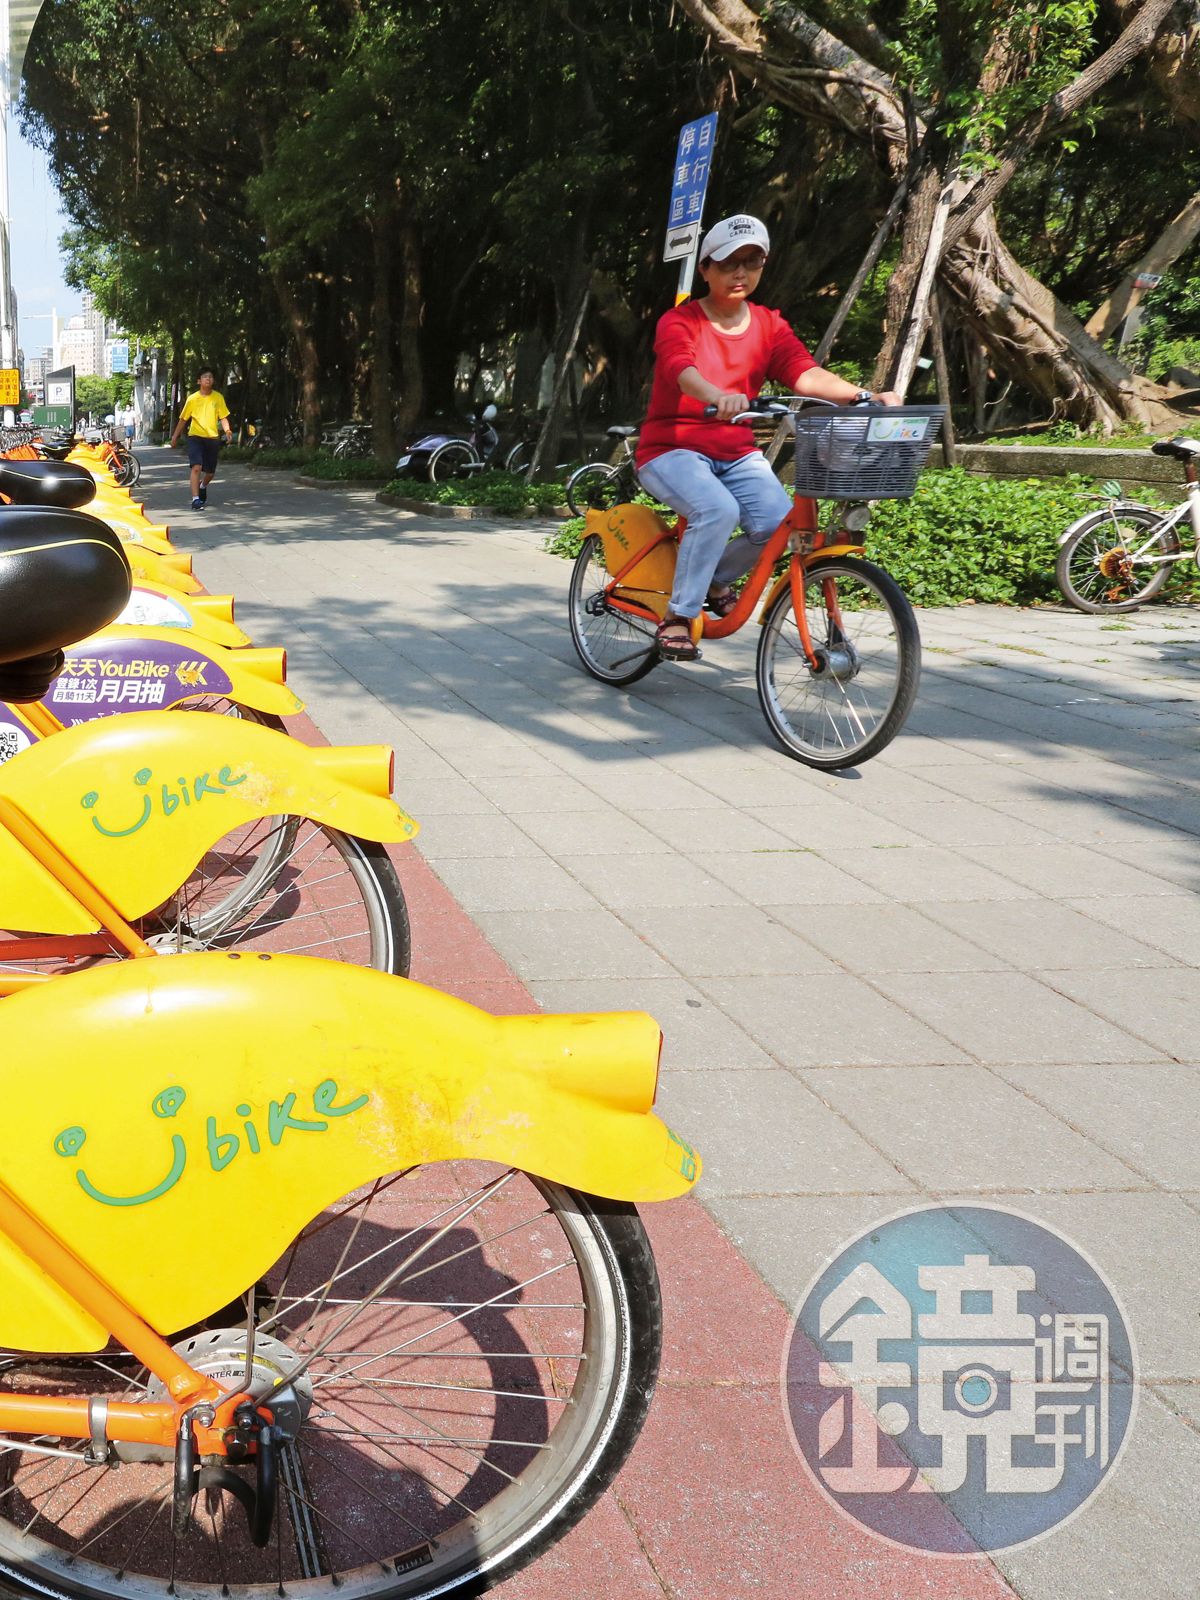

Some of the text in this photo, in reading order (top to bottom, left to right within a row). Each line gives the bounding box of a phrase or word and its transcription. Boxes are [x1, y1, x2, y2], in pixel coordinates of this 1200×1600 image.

[671, 126, 696, 223] 停車區
[686, 119, 712, 218] 自行車
[730, 228, 755, 238] CANADA
[55, 386, 63, 396] P
[55, 677, 99, 690] 登錄1次
[95, 679, 167, 704] 月月抽
[206, 1370, 232, 1379] INTER
